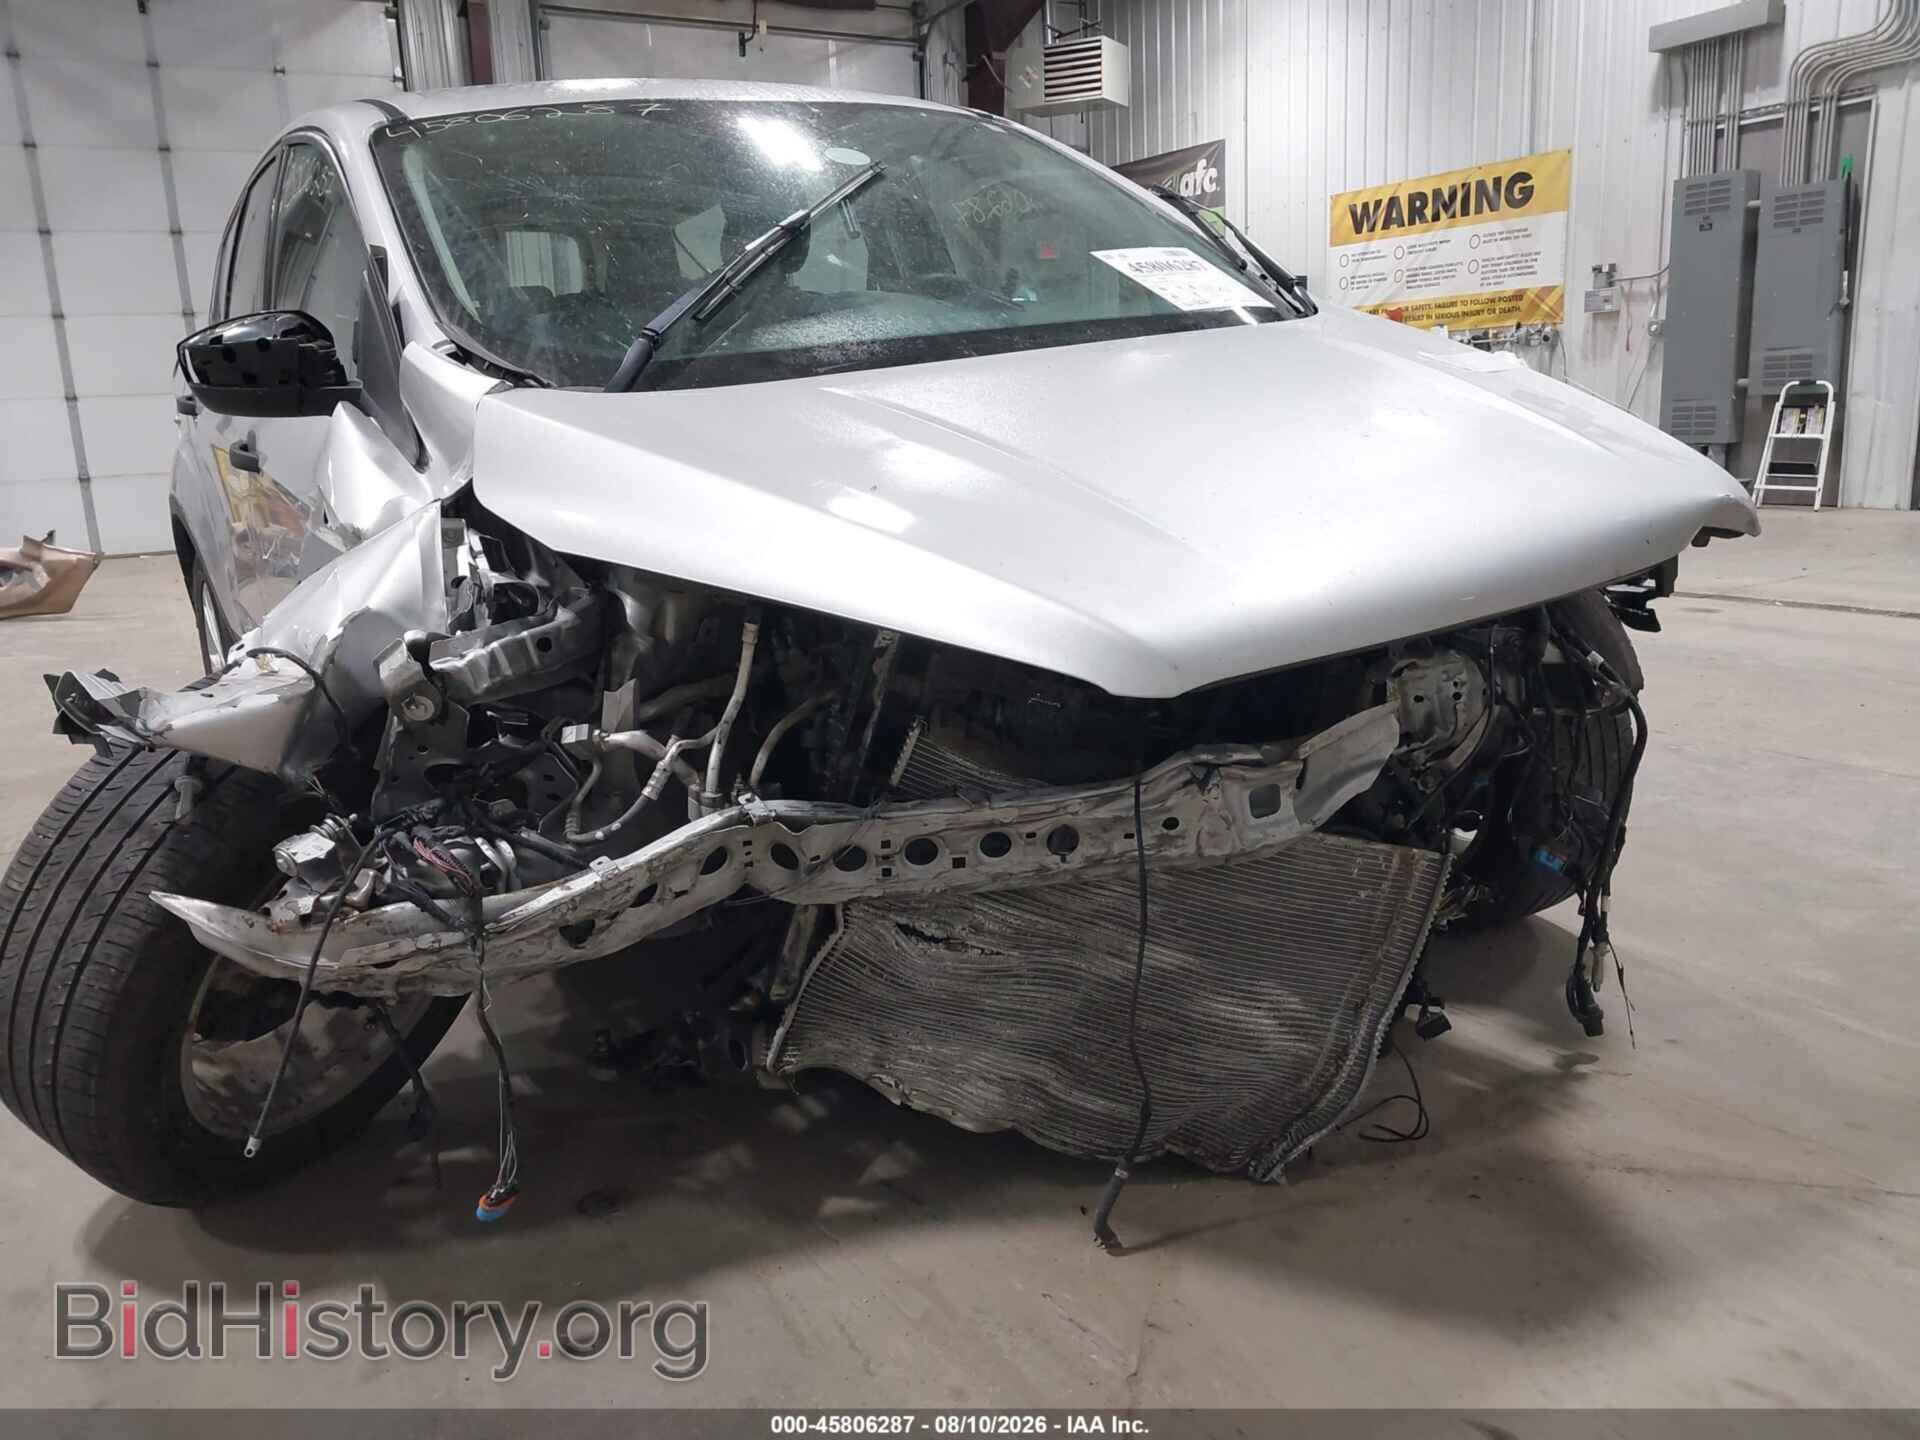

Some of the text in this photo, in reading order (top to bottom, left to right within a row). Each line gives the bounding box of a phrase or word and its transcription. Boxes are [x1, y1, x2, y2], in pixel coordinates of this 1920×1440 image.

[1180, 158, 1218, 197] afc
[1349, 171, 1535, 235] WARNING
[1459, 299, 1469, 307] TO
[1470, 296, 1496, 306] FOLLOW
[1497, 293, 1524, 303] POSTED
[1461, 308, 1485, 318] INJURY
[1486, 307, 1497, 315] OR
